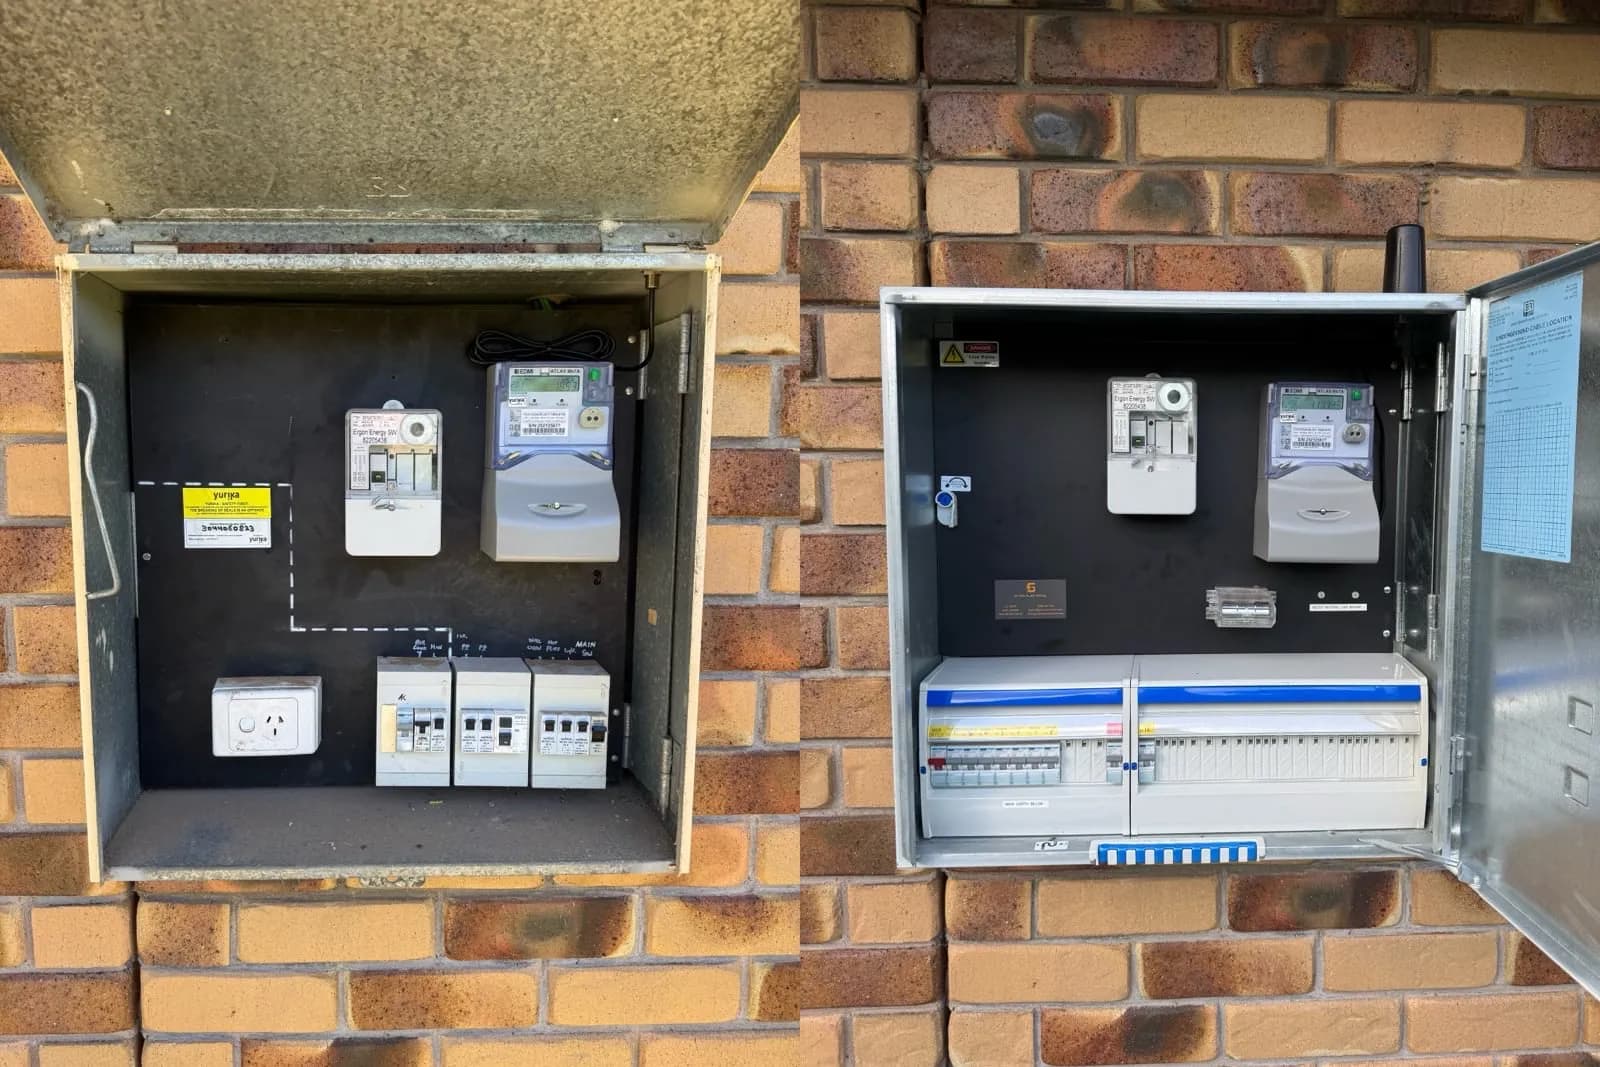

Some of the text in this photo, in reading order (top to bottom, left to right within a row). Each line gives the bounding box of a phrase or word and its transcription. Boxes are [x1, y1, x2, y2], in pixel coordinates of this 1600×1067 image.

[1129, 395, 1146, 403] Energy
[369, 428, 387, 437] Energy
[213, 491, 240, 501] yurika
[575, 640, 597, 648] MAIN
